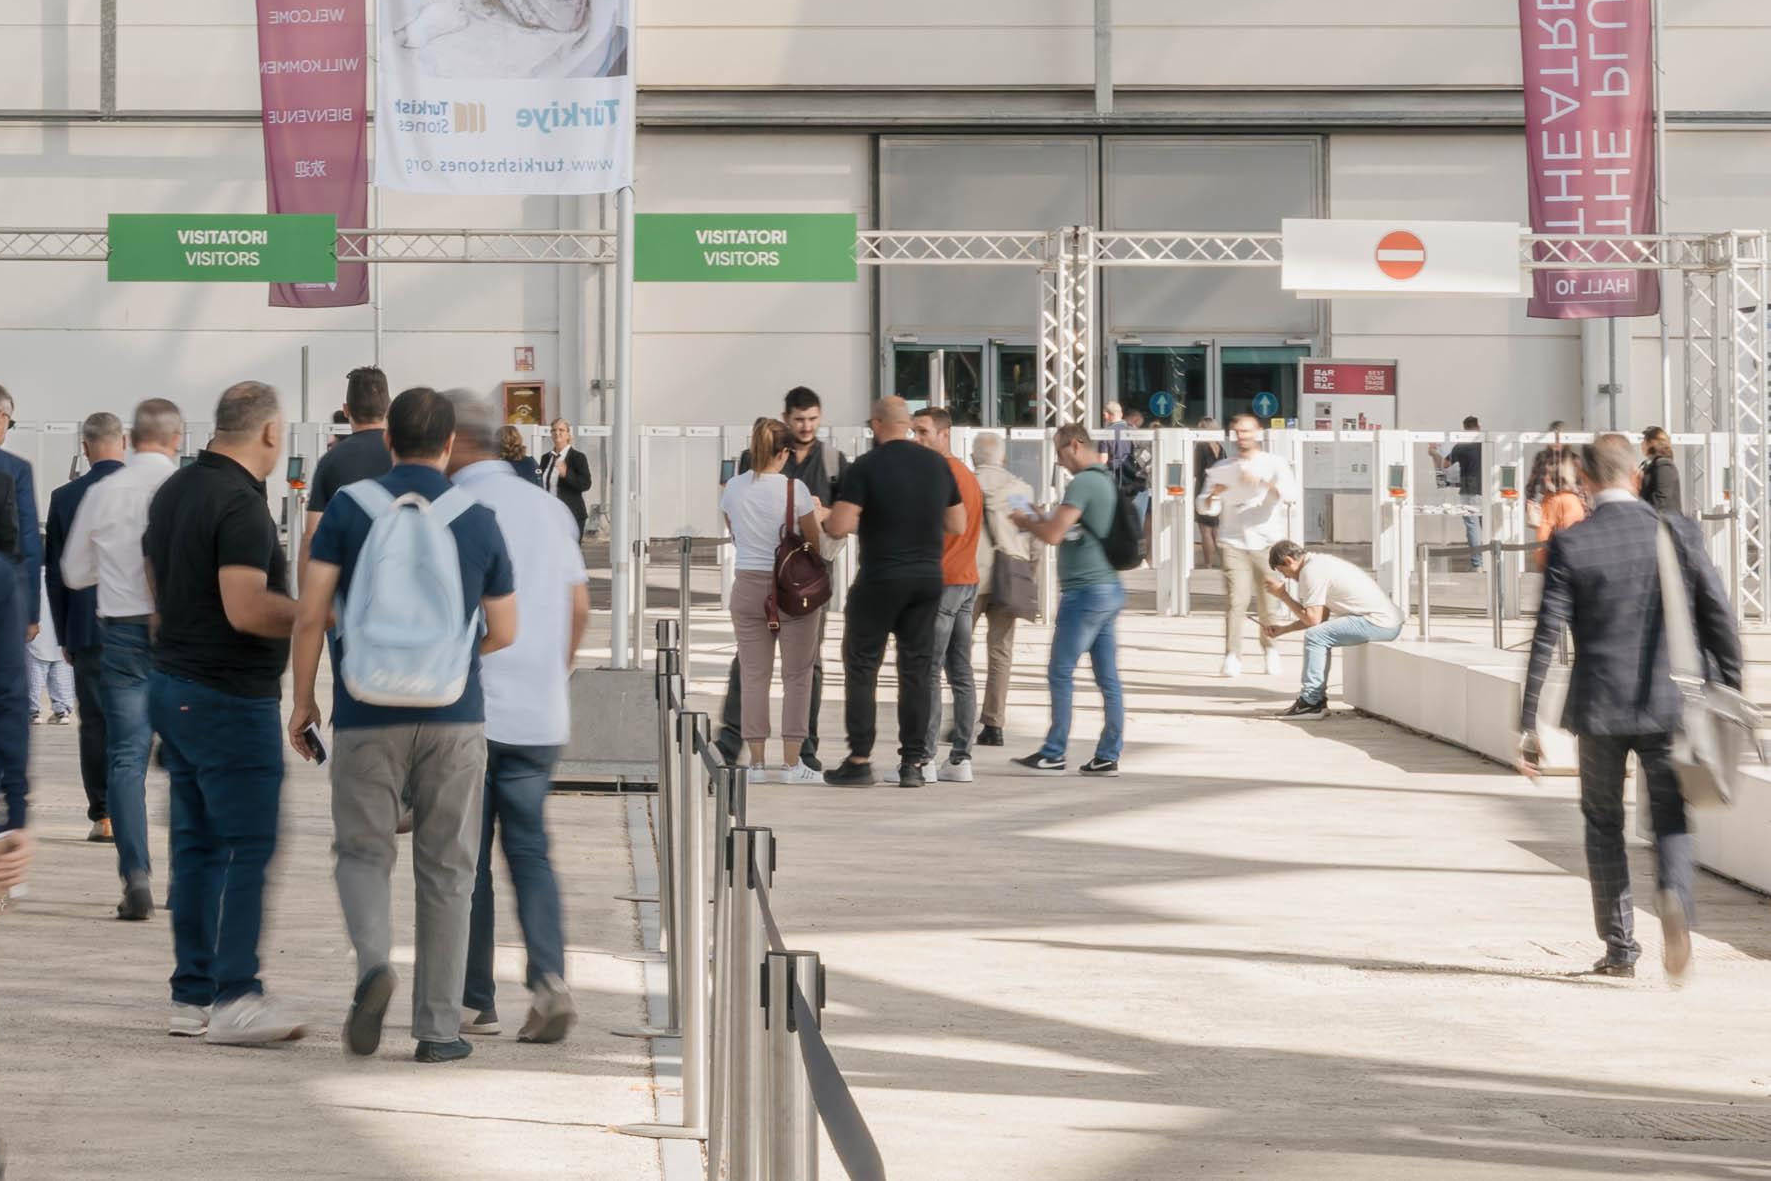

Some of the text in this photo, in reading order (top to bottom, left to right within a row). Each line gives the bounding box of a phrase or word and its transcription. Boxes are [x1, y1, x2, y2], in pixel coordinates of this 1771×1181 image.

[177, 230, 268, 245] VISITATORI
[695, 230, 788, 245] VISITATORI
[185, 251, 260, 266] VISITORS
[703, 251, 780, 266] VISITORS
